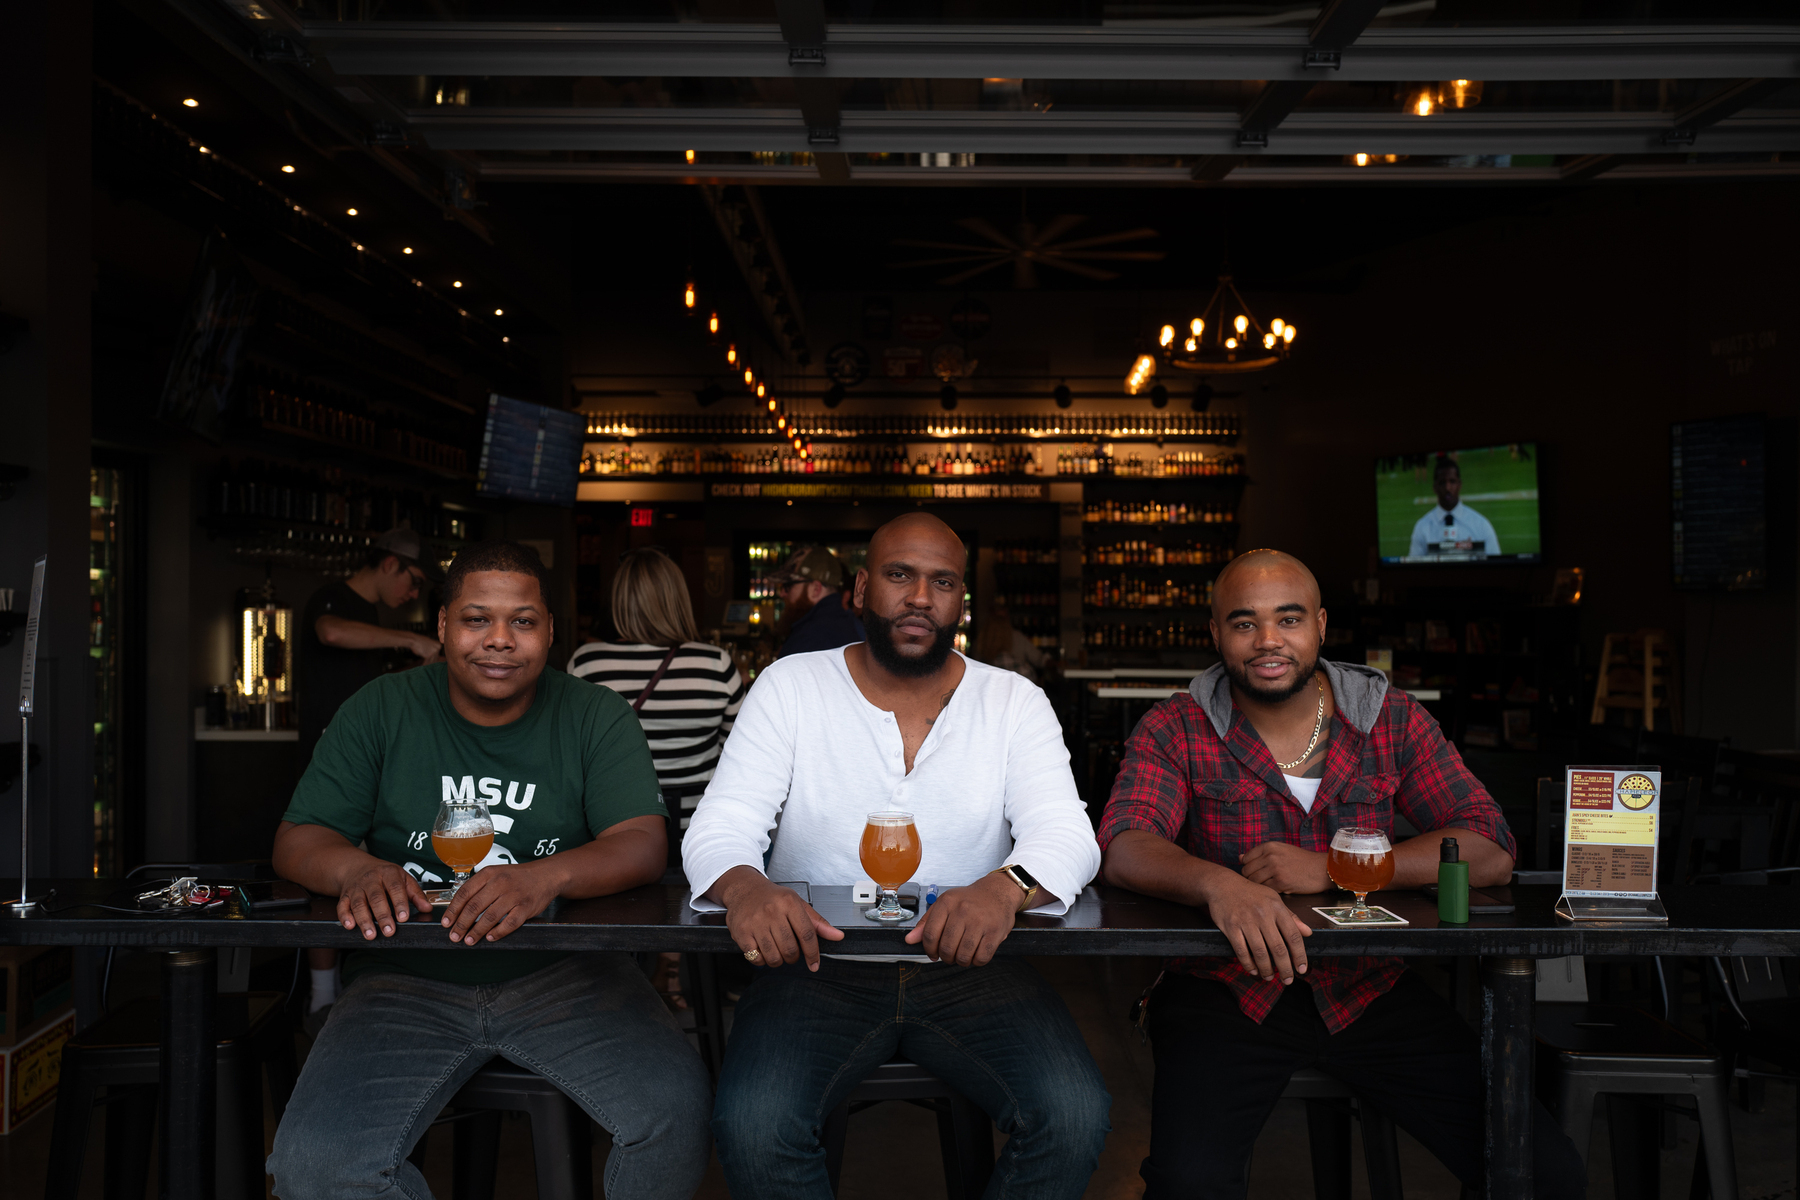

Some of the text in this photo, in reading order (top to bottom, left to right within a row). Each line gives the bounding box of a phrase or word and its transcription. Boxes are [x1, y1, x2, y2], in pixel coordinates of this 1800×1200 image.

[1710, 329, 1777, 356] WHAT'S ON
[1727, 356, 1754, 376] TAP
[711, 483, 741, 497] CHECK
[742, 483, 761, 497] OUT
[933, 484, 946, 498] TO
[946, 484, 964, 498] SEE
[965, 484, 999, 498] WHAT'S
[1000, 484, 1011, 498] IN
[1012, 484, 1042, 498] STOCK
[442, 775, 536, 810] MSU
[407, 831, 560, 856] 18 55
